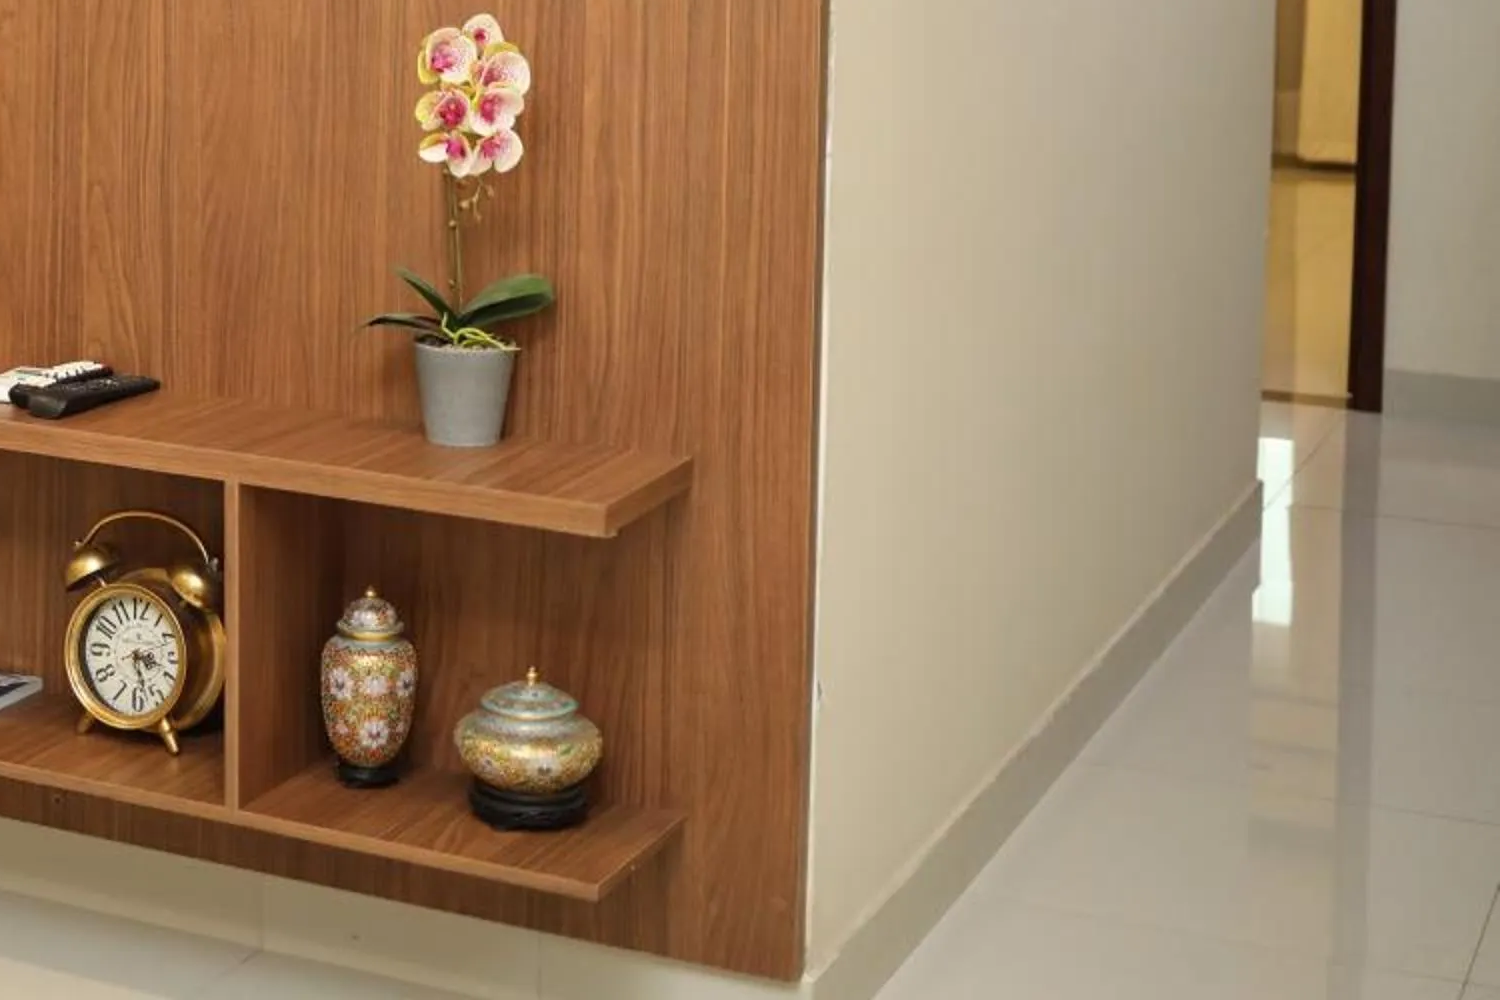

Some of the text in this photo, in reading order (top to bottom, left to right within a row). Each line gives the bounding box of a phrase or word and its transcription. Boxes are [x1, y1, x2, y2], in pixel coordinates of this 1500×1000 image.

[112, 600, 130, 625] 11
[133, 598, 150, 620] 12
[96, 615, 117, 640] 10
[154, 614, 163, 627] 1
[91, 642, 111, 657] 9
[96, 663, 116, 683] 8
[113, 679, 128, 701] 7
[132, 687, 144, 712] 6
